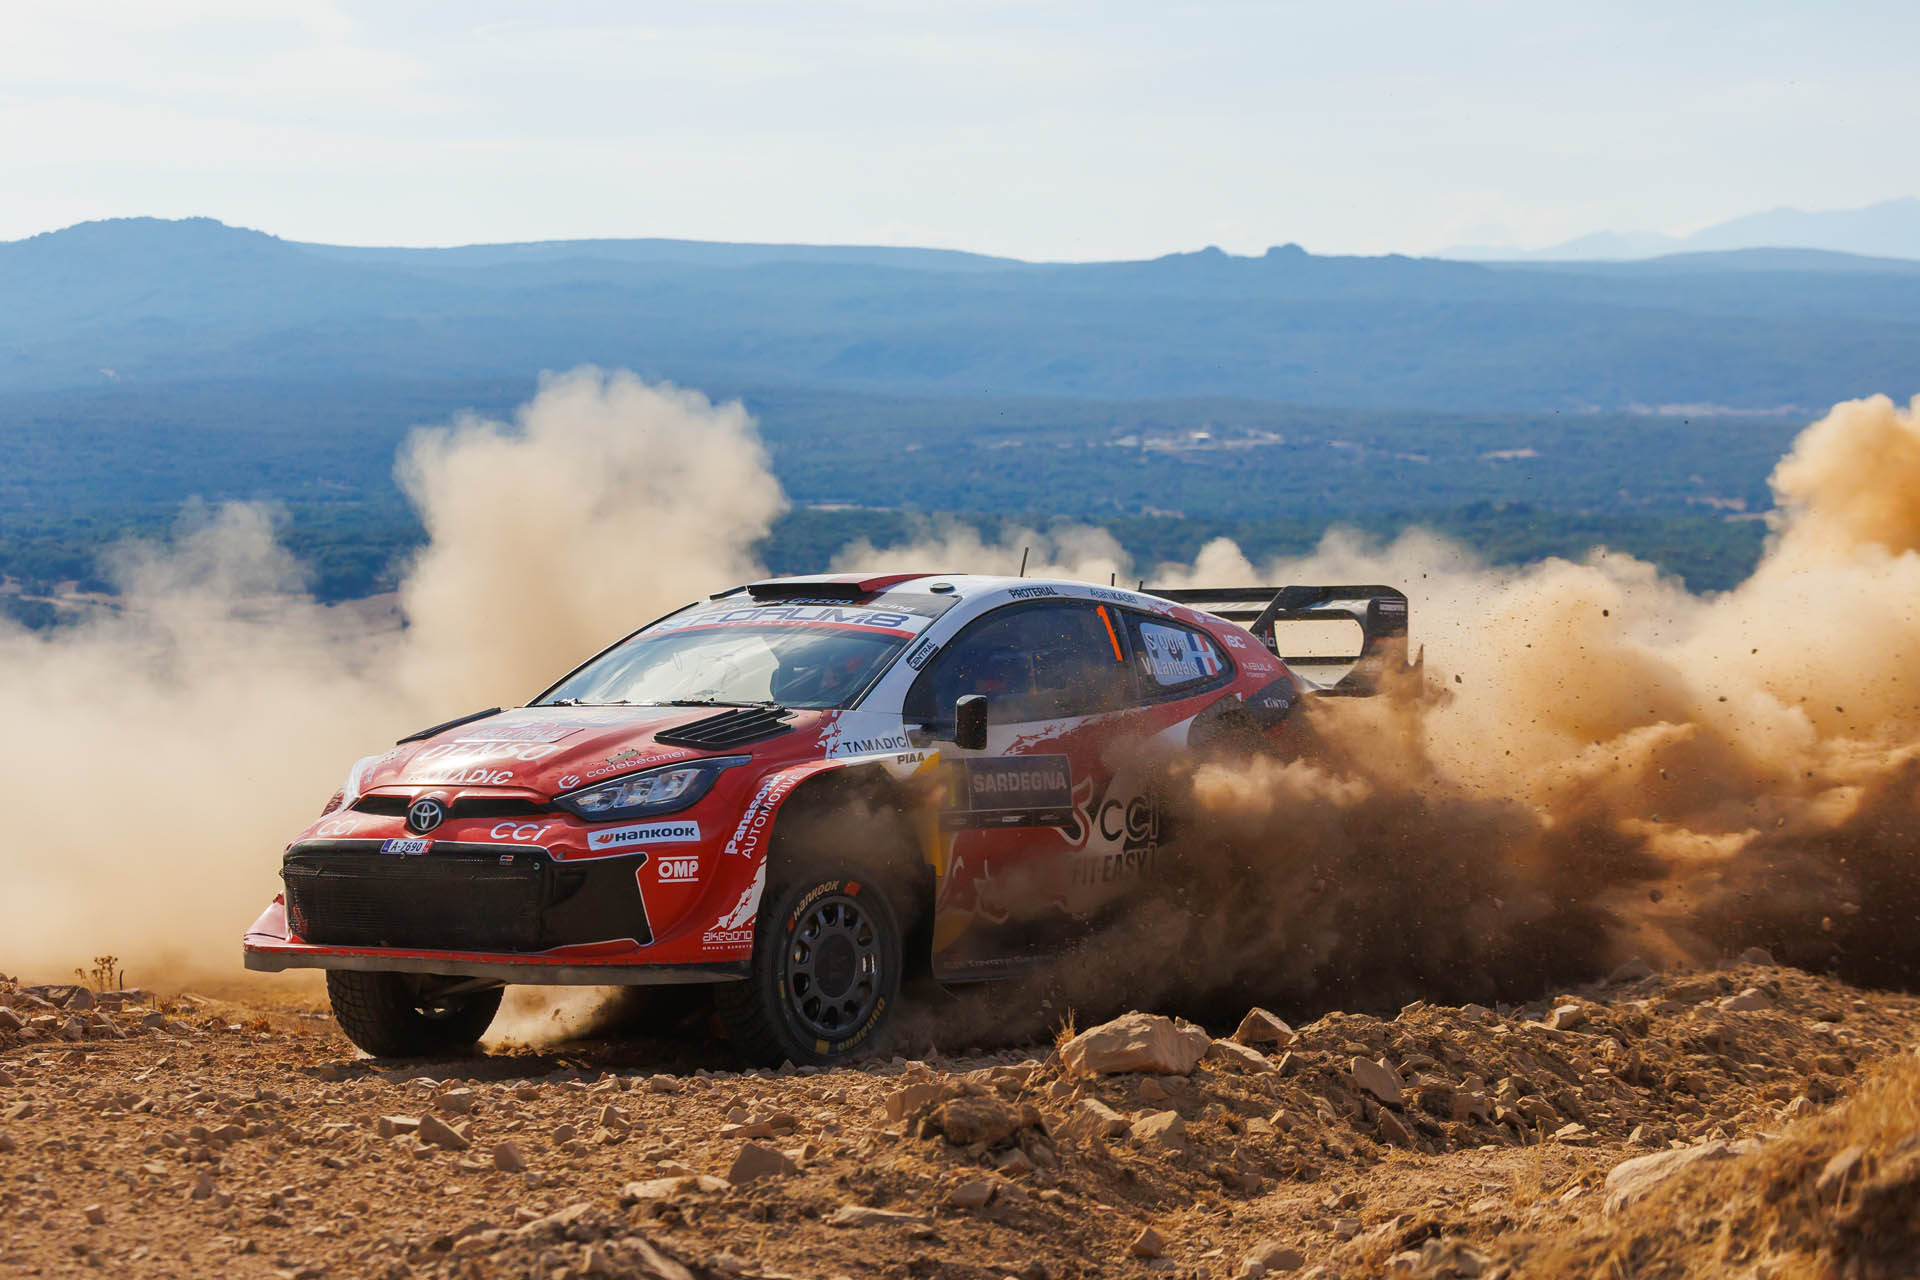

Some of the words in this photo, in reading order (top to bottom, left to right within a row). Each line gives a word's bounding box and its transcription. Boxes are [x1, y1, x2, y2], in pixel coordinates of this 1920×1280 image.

[1009, 586, 1059, 599] PROTERIAL
[1096, 605, 1123, 661] 1
[909, 641, 936, 668] CENTRAL
[842, 736, 907, 753] TAMADIC
[586, 750, 688, 779] codebeamer
[897, 752, 925, 765] PIAA
[973, 771, 1068, 793] SARDEGNA
[724, 773, 787, 855] Panasonic
[742, 774, 804, 860] AUTOMOTIVE
[658, 860, 699, 878] OMP
